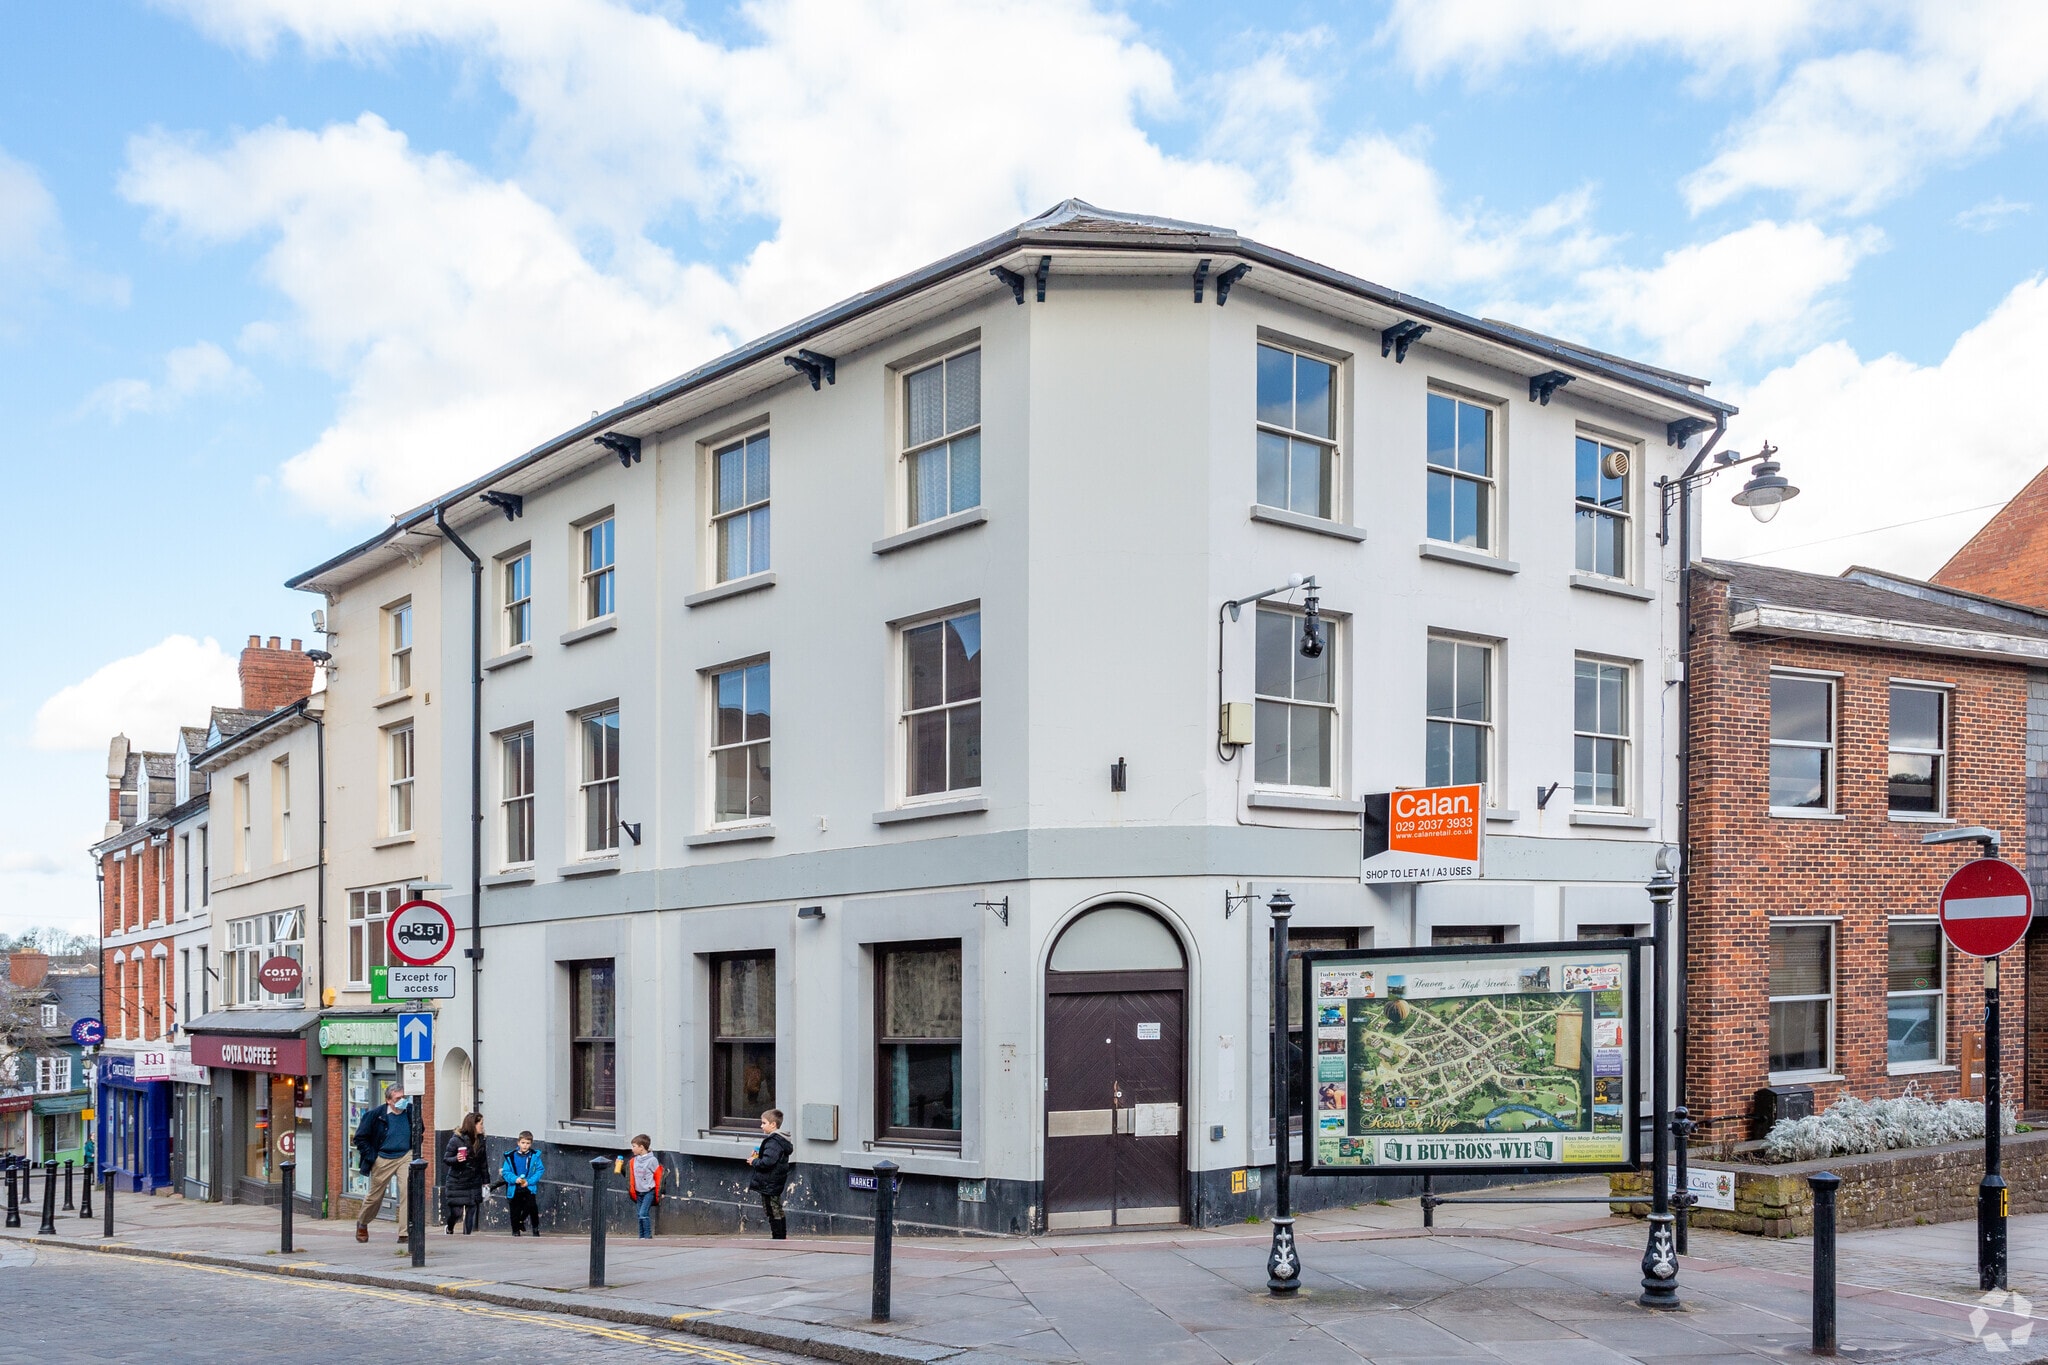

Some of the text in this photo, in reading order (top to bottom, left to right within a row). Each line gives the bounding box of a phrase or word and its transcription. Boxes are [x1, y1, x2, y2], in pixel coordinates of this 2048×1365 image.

[1396, 793, 1473, 818] Calan.
[1396, 818, 1473, 832] 029 2037 3933
[1396, 829, 1473, 839] www.calanretail.co.uk
[1366, 870, 1388, 879] SHOP
[1391, 869, 1401, 878] TO
[1403, 868, 1418, 877] LET
[1420, 868, 1430, 877] A1
[1437, 867, 1448, 876] A3
[1449, 866, 1472, 876] USES
[413, 924, 442, 936] 3.5T
[264, 968, 298, 977] COSTA
[395, 972, 448, 983] Except for
[404, 985, 439, 993] access
[1413, 977, 1444, 988] Heaven
[1460, 978, 1480, 992] High
[221, 1044, 272, 1066] COSTA COFFEE
[1361, 1112, 1458, 1133] Ross-on-Wye
[1406, 1144, 1412, 1160] I
[1418, 1144, 1449, 1160] BUY
[1455, 1143, 1492, 1160] ROSS
[1499, 1142, 1532, 1158] WYE
[850, 1176, 874, 1187] MARKET
[1234, 1173, 1245, 1190] H
[1692, 1177, 1714, 1189] Care
